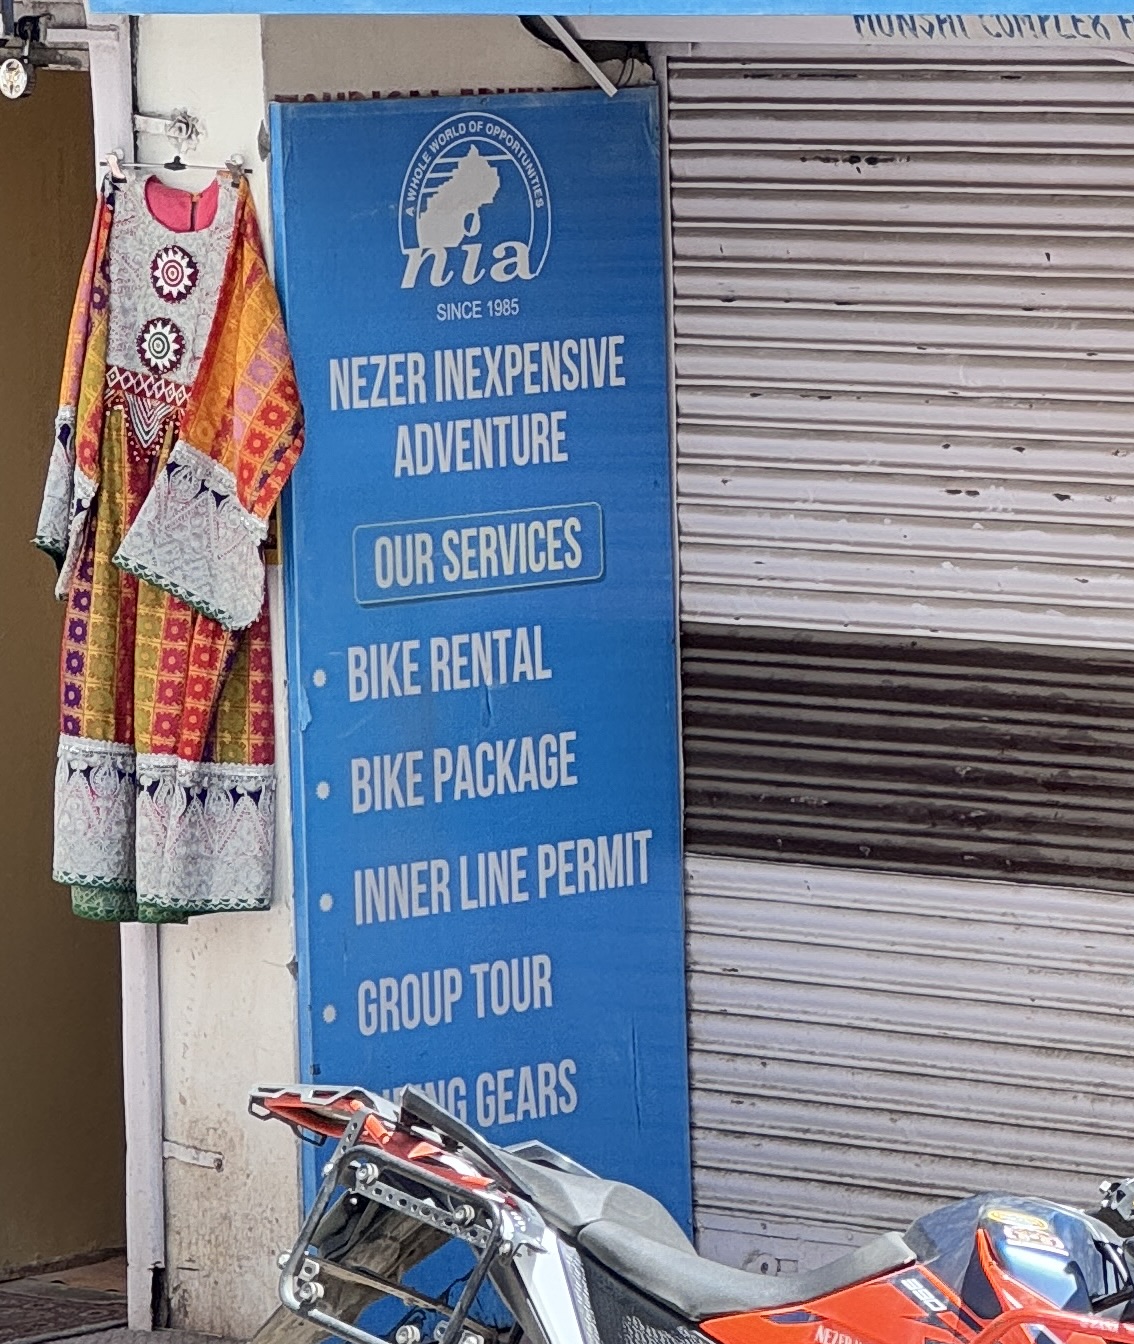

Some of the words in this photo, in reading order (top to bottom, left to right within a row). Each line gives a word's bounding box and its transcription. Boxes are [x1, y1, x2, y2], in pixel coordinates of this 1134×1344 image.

[429, 122, 467, 152] WORLD
[469, 120, 484, 133] OF
[407, 151, 430, 203] WHOLE
[485, 123, 545, 209] OPPORTUNITIES
[405, 207, 416, 217] A
[400, 241, 539, 289] nia
[436, 301, 482, 321] SINCE
[487, 298, 520, 317] 1985
[329, 351, 427, 411] NEZER
[434, 335, 626, 403] INEXPENSIVE
[394, 410, 569, 478] ADVENTURE
[374, 532, 435, 589] OUR
[441, 516, 583, 582] SERVICES
[347, 639, 422, 703] BIKE
[429, 625, 552, 693] RENTAL
[350, 750, 425, 814] BIKE
[432, 731, 578, 803] PACKAGE
[354, 858, 451, 926] INNER
[459, 847, 530, 911] LINE
[537, 829, 653, 899] PERMIT
[357, 967, 463, 1037] GROUP
[469, 954, 553, 1019] TOUR
[475, 1058, 578, 1128] GEARS
